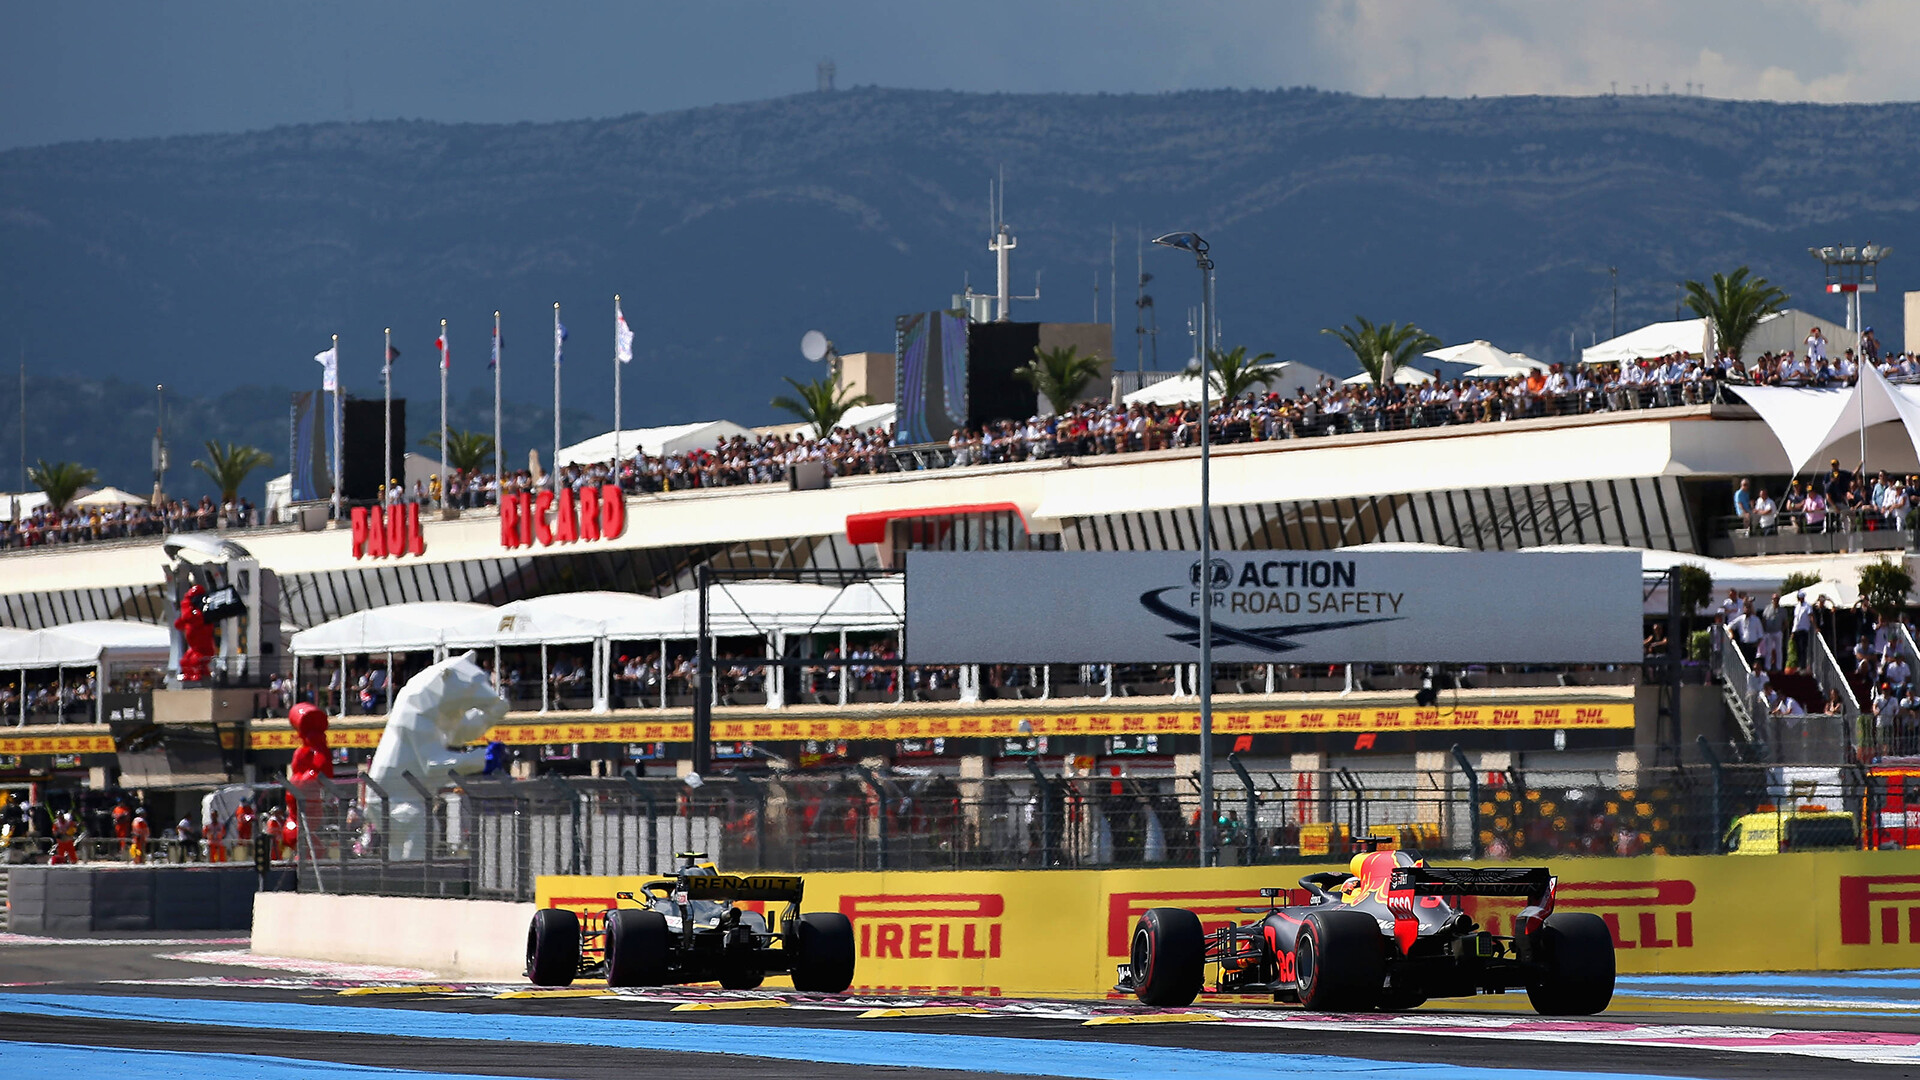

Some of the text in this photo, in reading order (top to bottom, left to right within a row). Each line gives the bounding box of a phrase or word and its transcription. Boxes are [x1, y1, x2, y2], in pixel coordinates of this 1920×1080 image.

[351, 485, 625, 558] PAUL RICARD
[1239, 561, 1355, 588] ACTION
[1190, 592, 1405, 614] FR ROAD SAFETY
[1259, 714, 1290, 729] DHL
[1298, 713, 1328, 729] DHL
[1336, 713, 1365, 728] DHL
[1373, 711, 1403, 728] DHL
[1412, 709, 1443, 727] DHL
[1452, 709, 1482, 726] DHL
[1491, 708, 1522, 726] DHL
[1531, 708, 1563, 726] DHL
[1571, 707, 1605, 725] DHL
[694, 877, 790, 889] RENAULT
[839, 894, 1004, 958] PIRELLI
